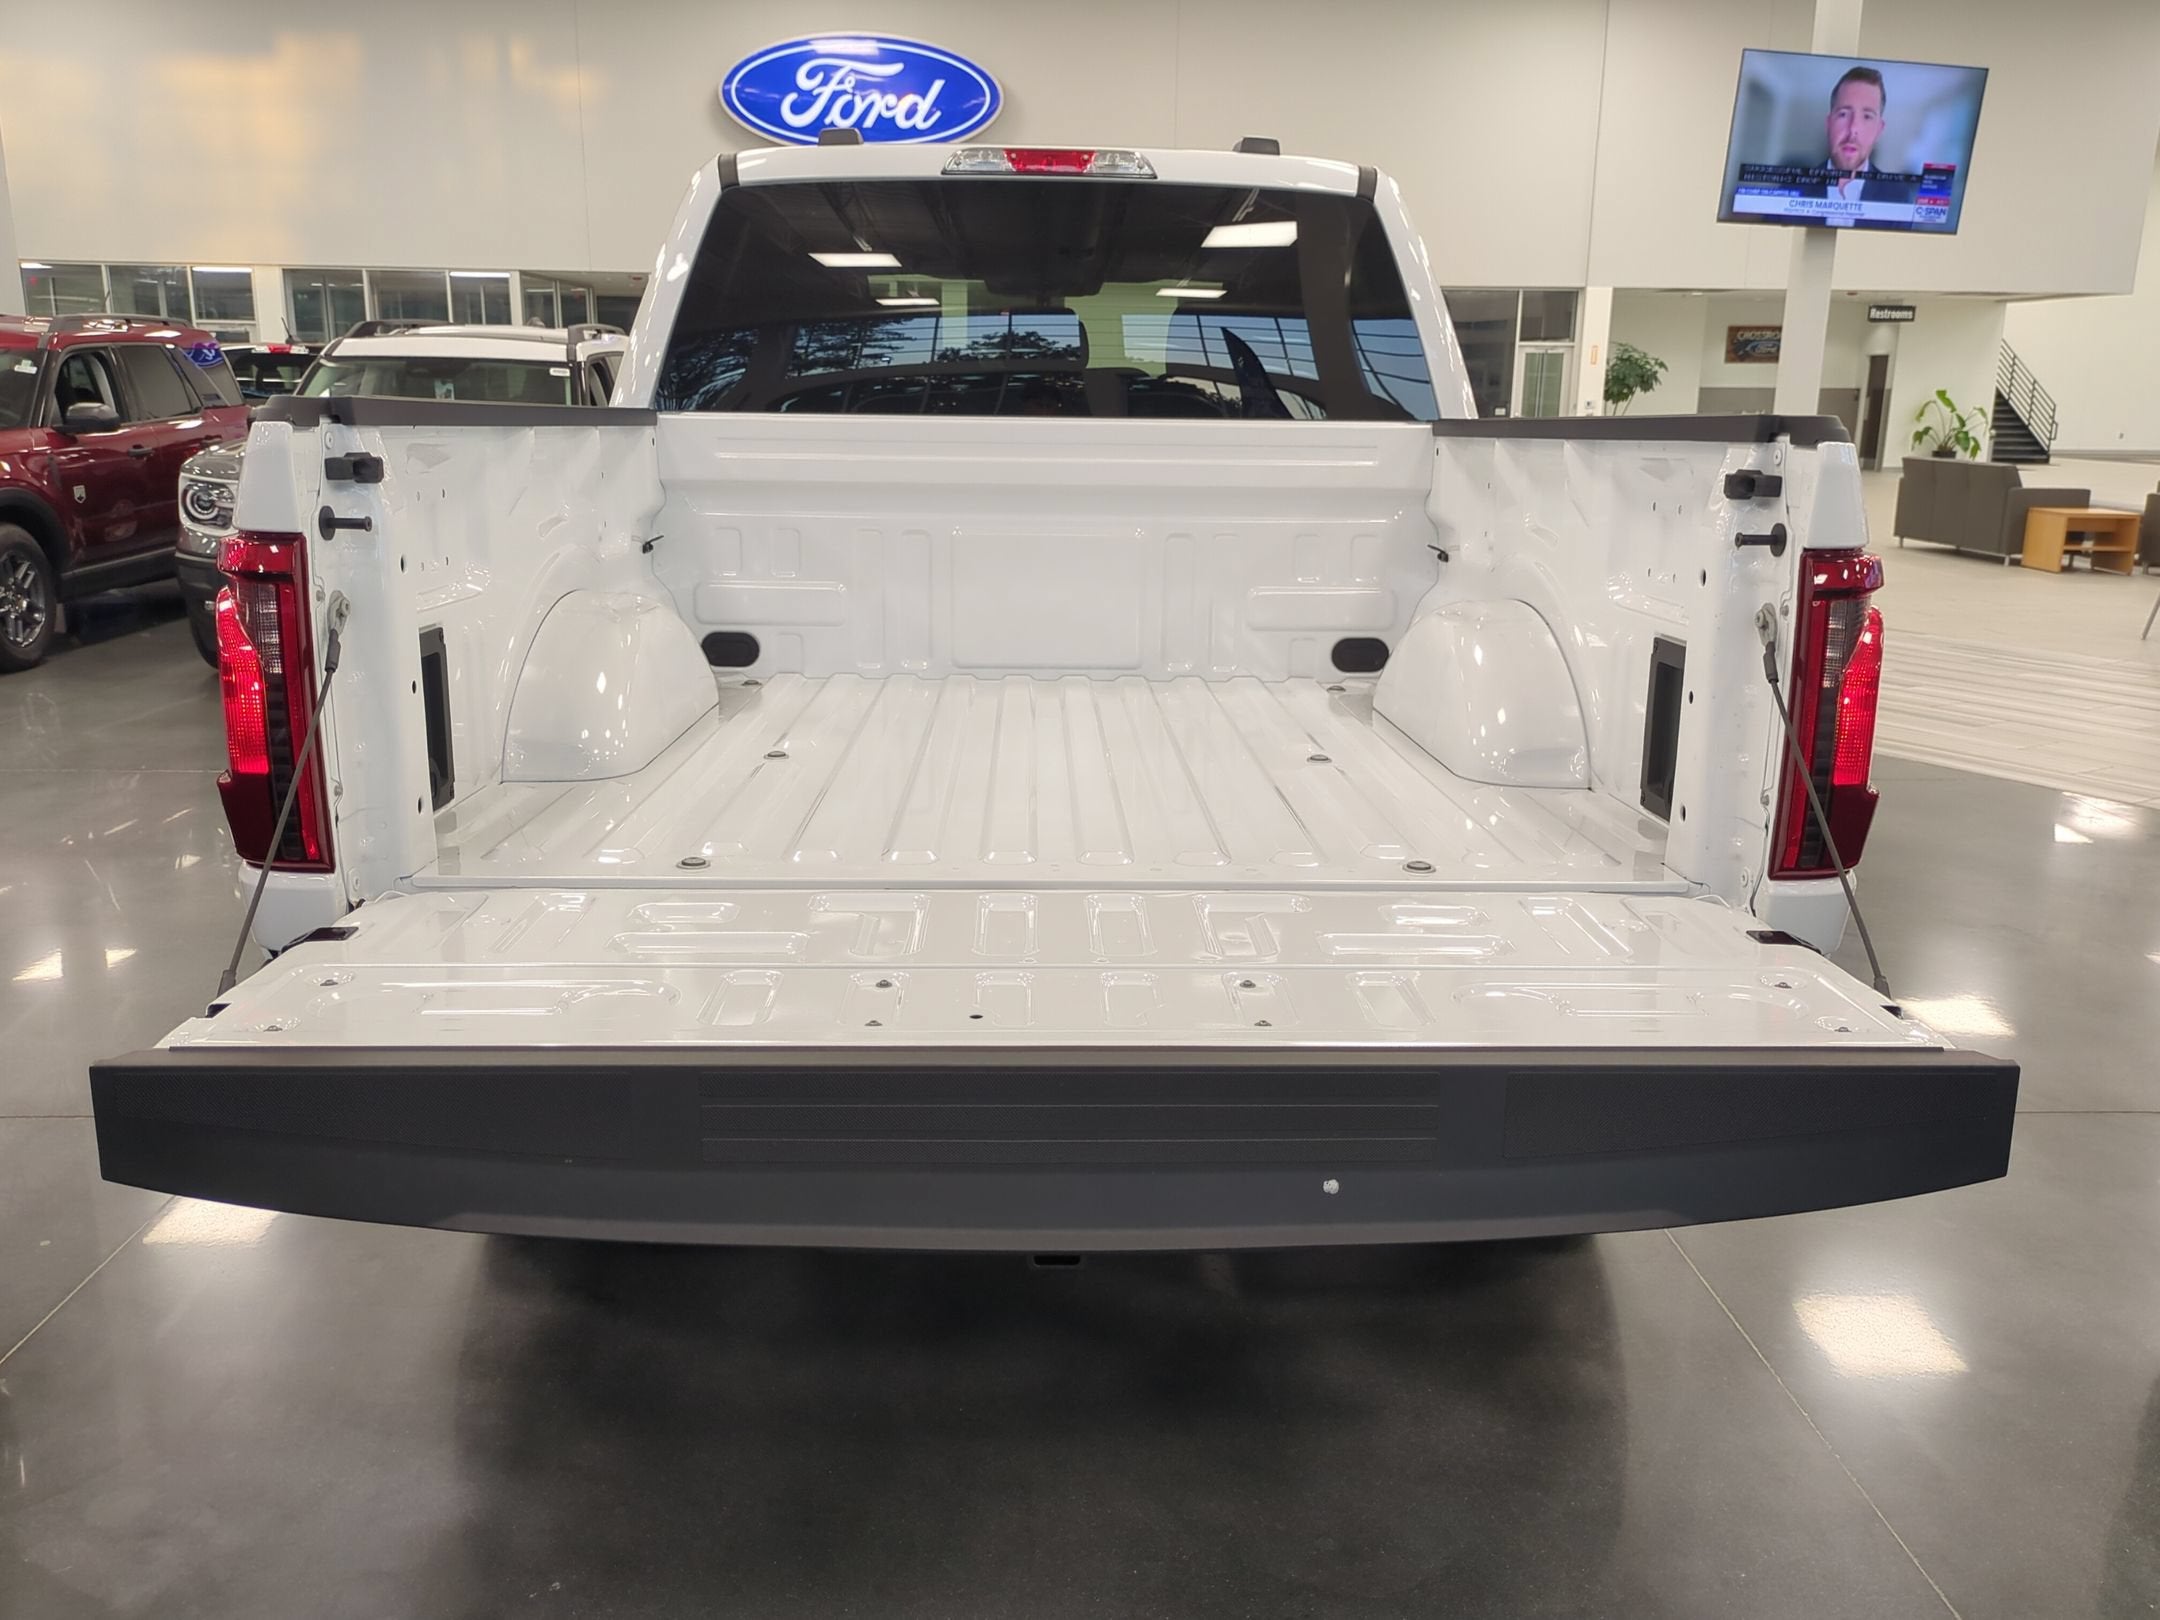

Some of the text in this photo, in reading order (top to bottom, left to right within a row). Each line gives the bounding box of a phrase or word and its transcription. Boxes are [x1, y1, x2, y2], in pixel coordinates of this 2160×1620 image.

[780, 57, 946, 130] Ford
[1789, 199, 1813, 209] CHRIS
[1815, 200, 1862, 211] MARQUETTE
[1870, 308, 1913, 320] Restrooms
[1737, 331, 1781, 341] CROSSRO
